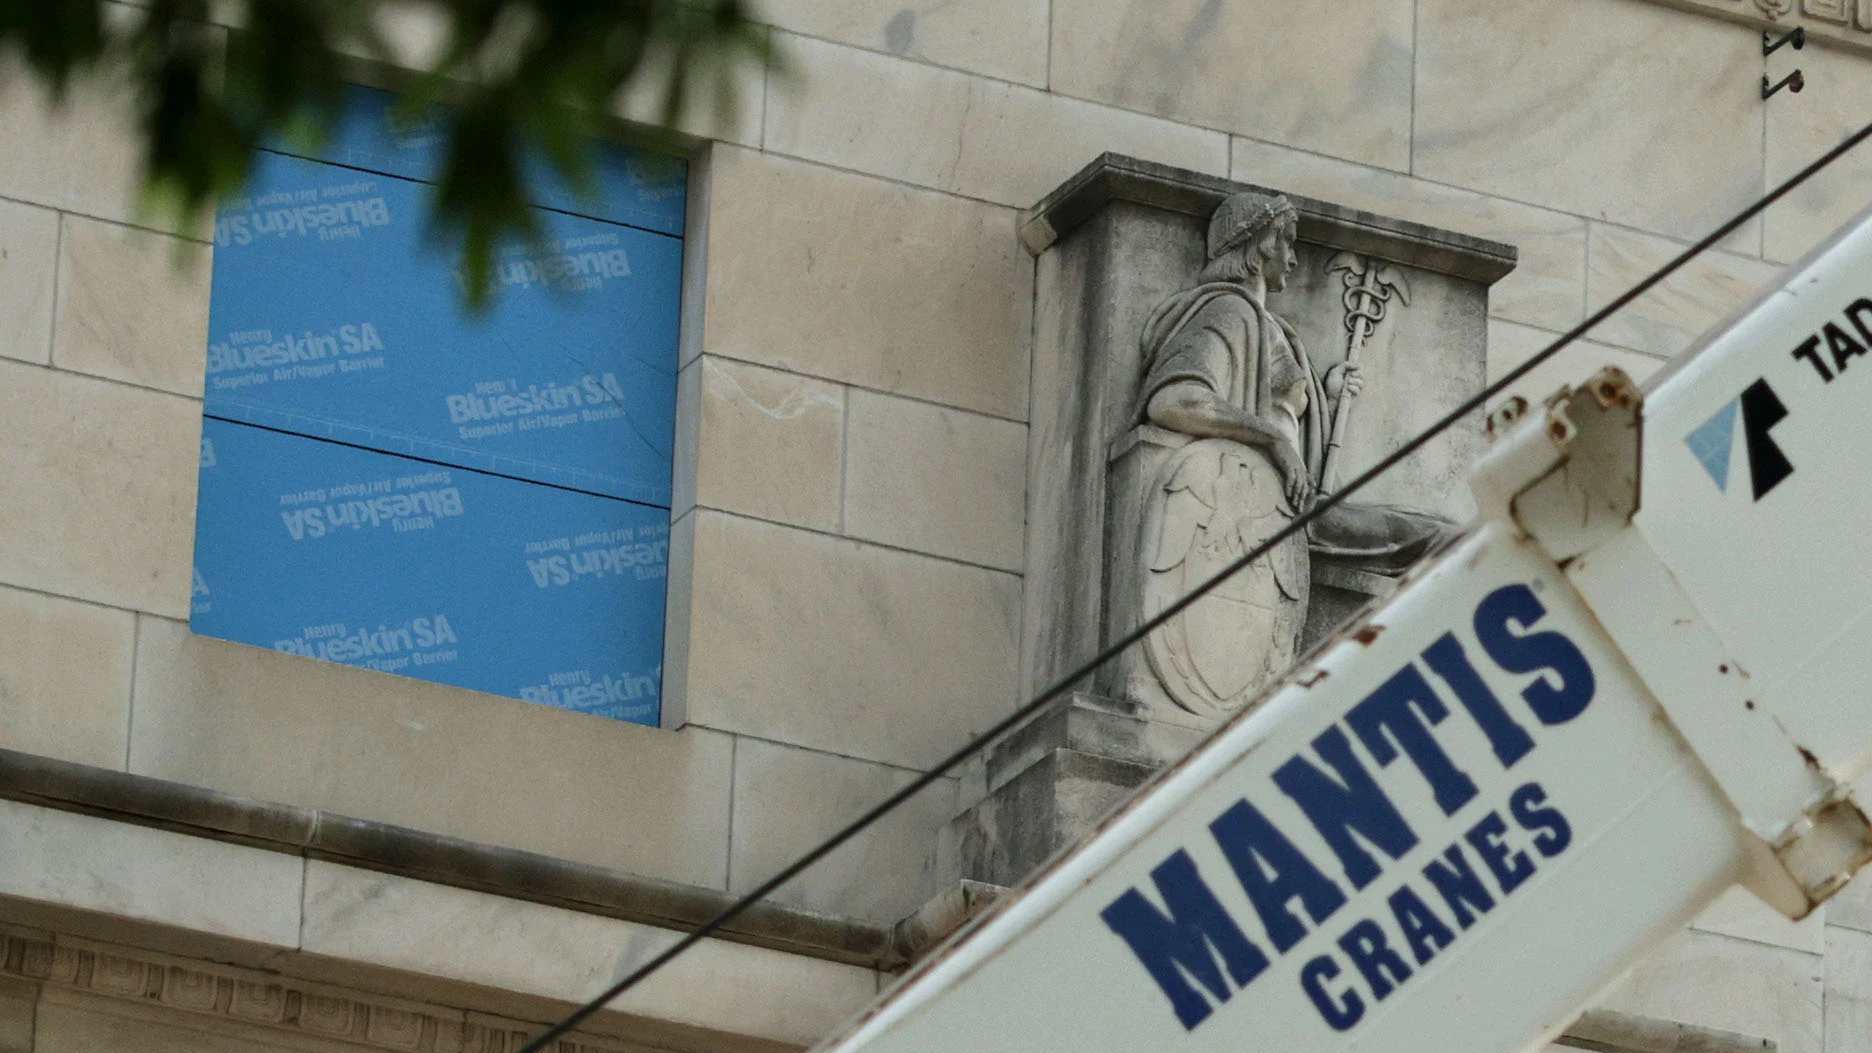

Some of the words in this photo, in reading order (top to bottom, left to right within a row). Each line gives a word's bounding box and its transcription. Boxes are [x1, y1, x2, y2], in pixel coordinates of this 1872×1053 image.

[447, 383, 581, 424] Blueskin
[570, 540, 668, 578] ueskin
[1100, 583, 1596, 1032] MANTIS
[1300, 782, 1573, 1032] CRANES
